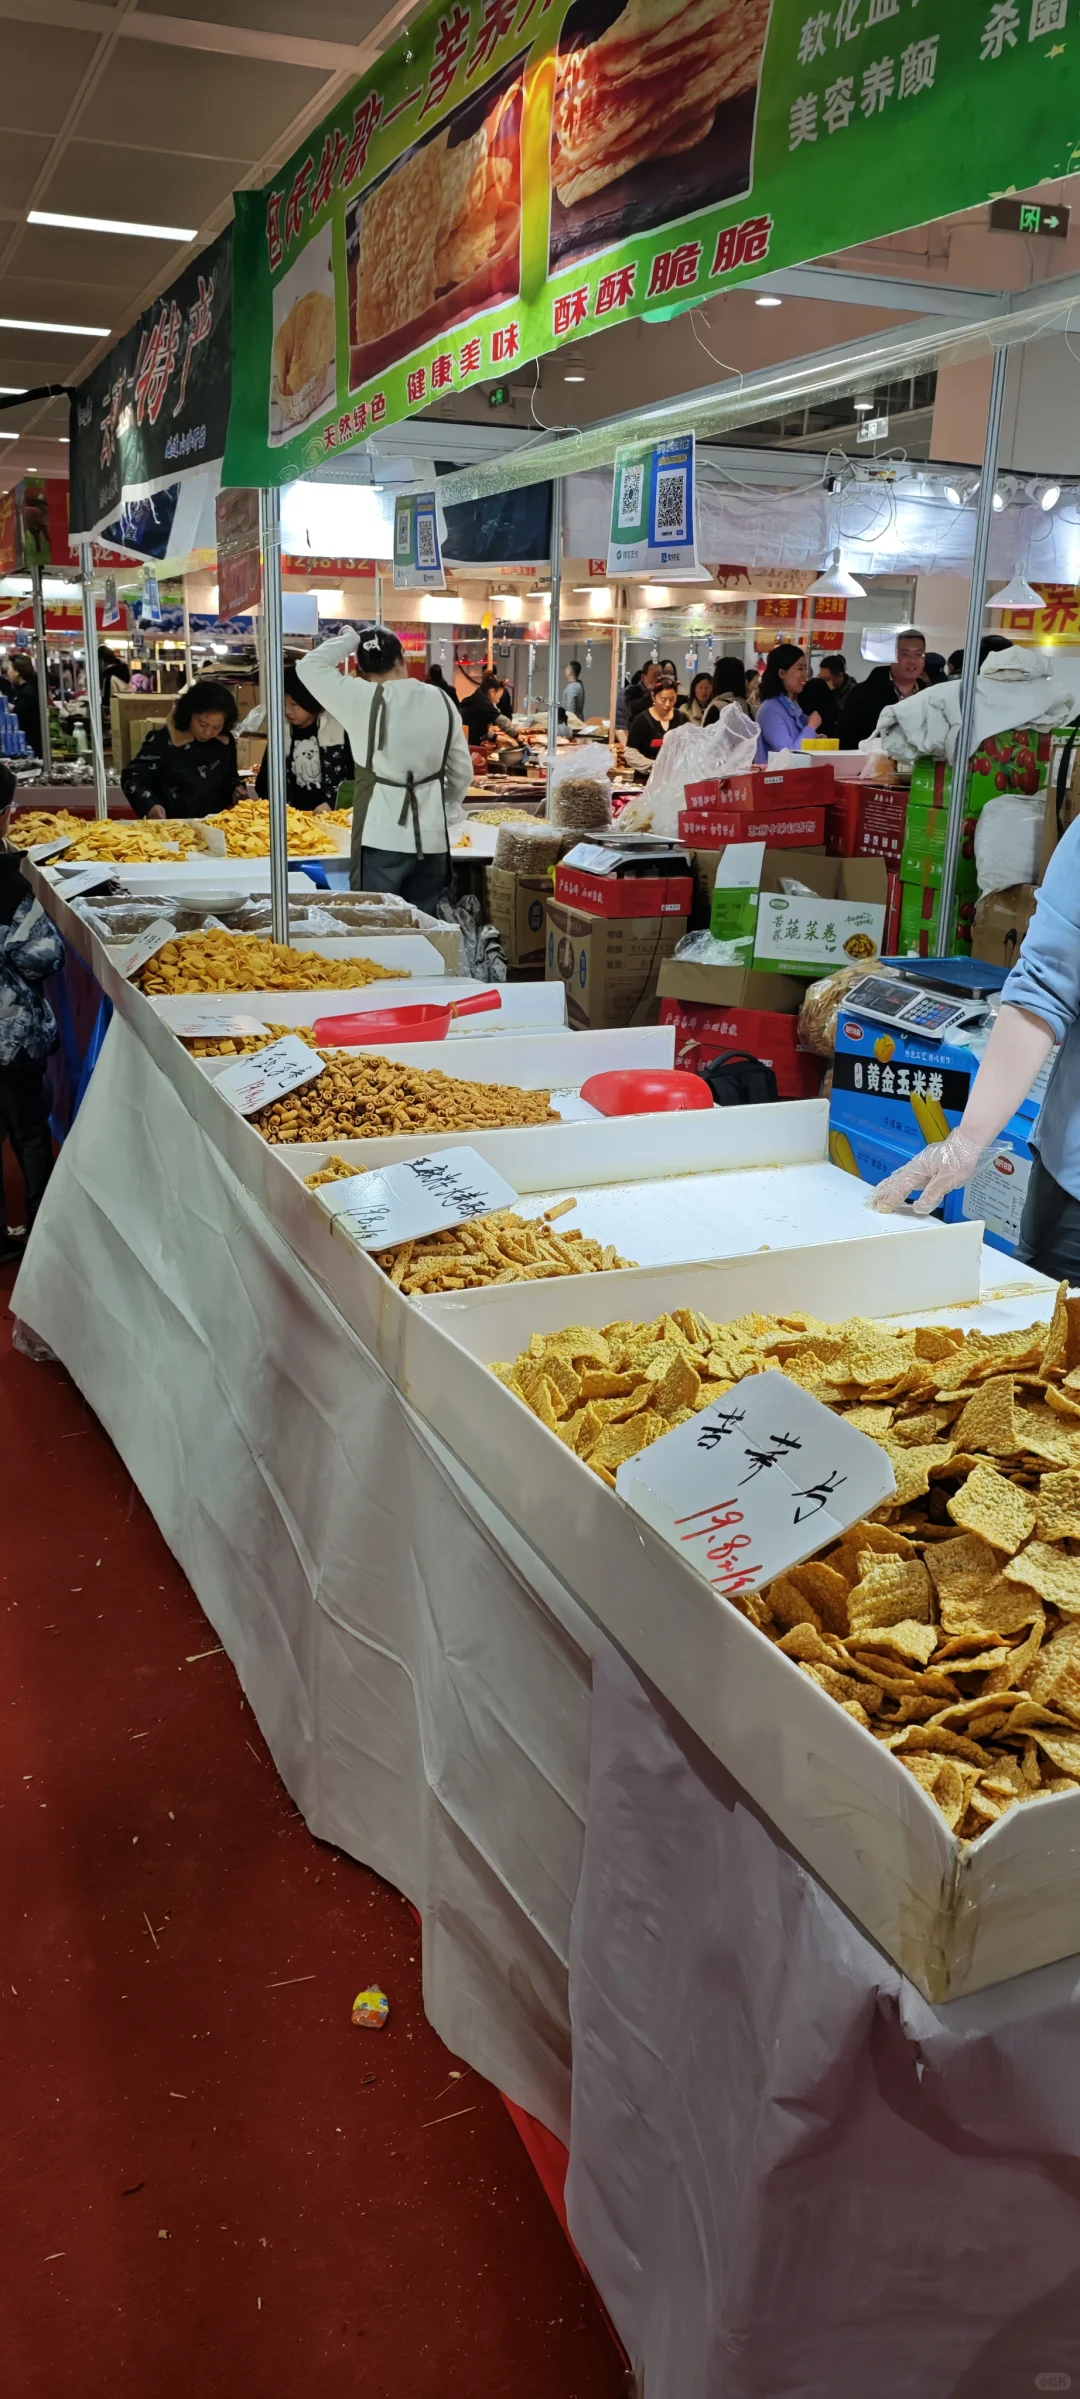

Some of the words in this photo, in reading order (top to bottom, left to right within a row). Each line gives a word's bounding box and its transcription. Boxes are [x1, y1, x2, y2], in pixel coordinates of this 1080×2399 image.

[797, 0, 921, 66] 软化血
[788, 34, 941, 151] 美容养颜
[322, 392, 387, 452] 天然绿色
[406, 321, 520, 405] 健康美味
[554, 214, 774, 336] 酥酥脆脆
[784, 918, 837, 942] 蔬菜卷
[867, 1062, 943, 1101] 黄金玉米卷
[697, 1406, 847, 1524] 苦荞片
